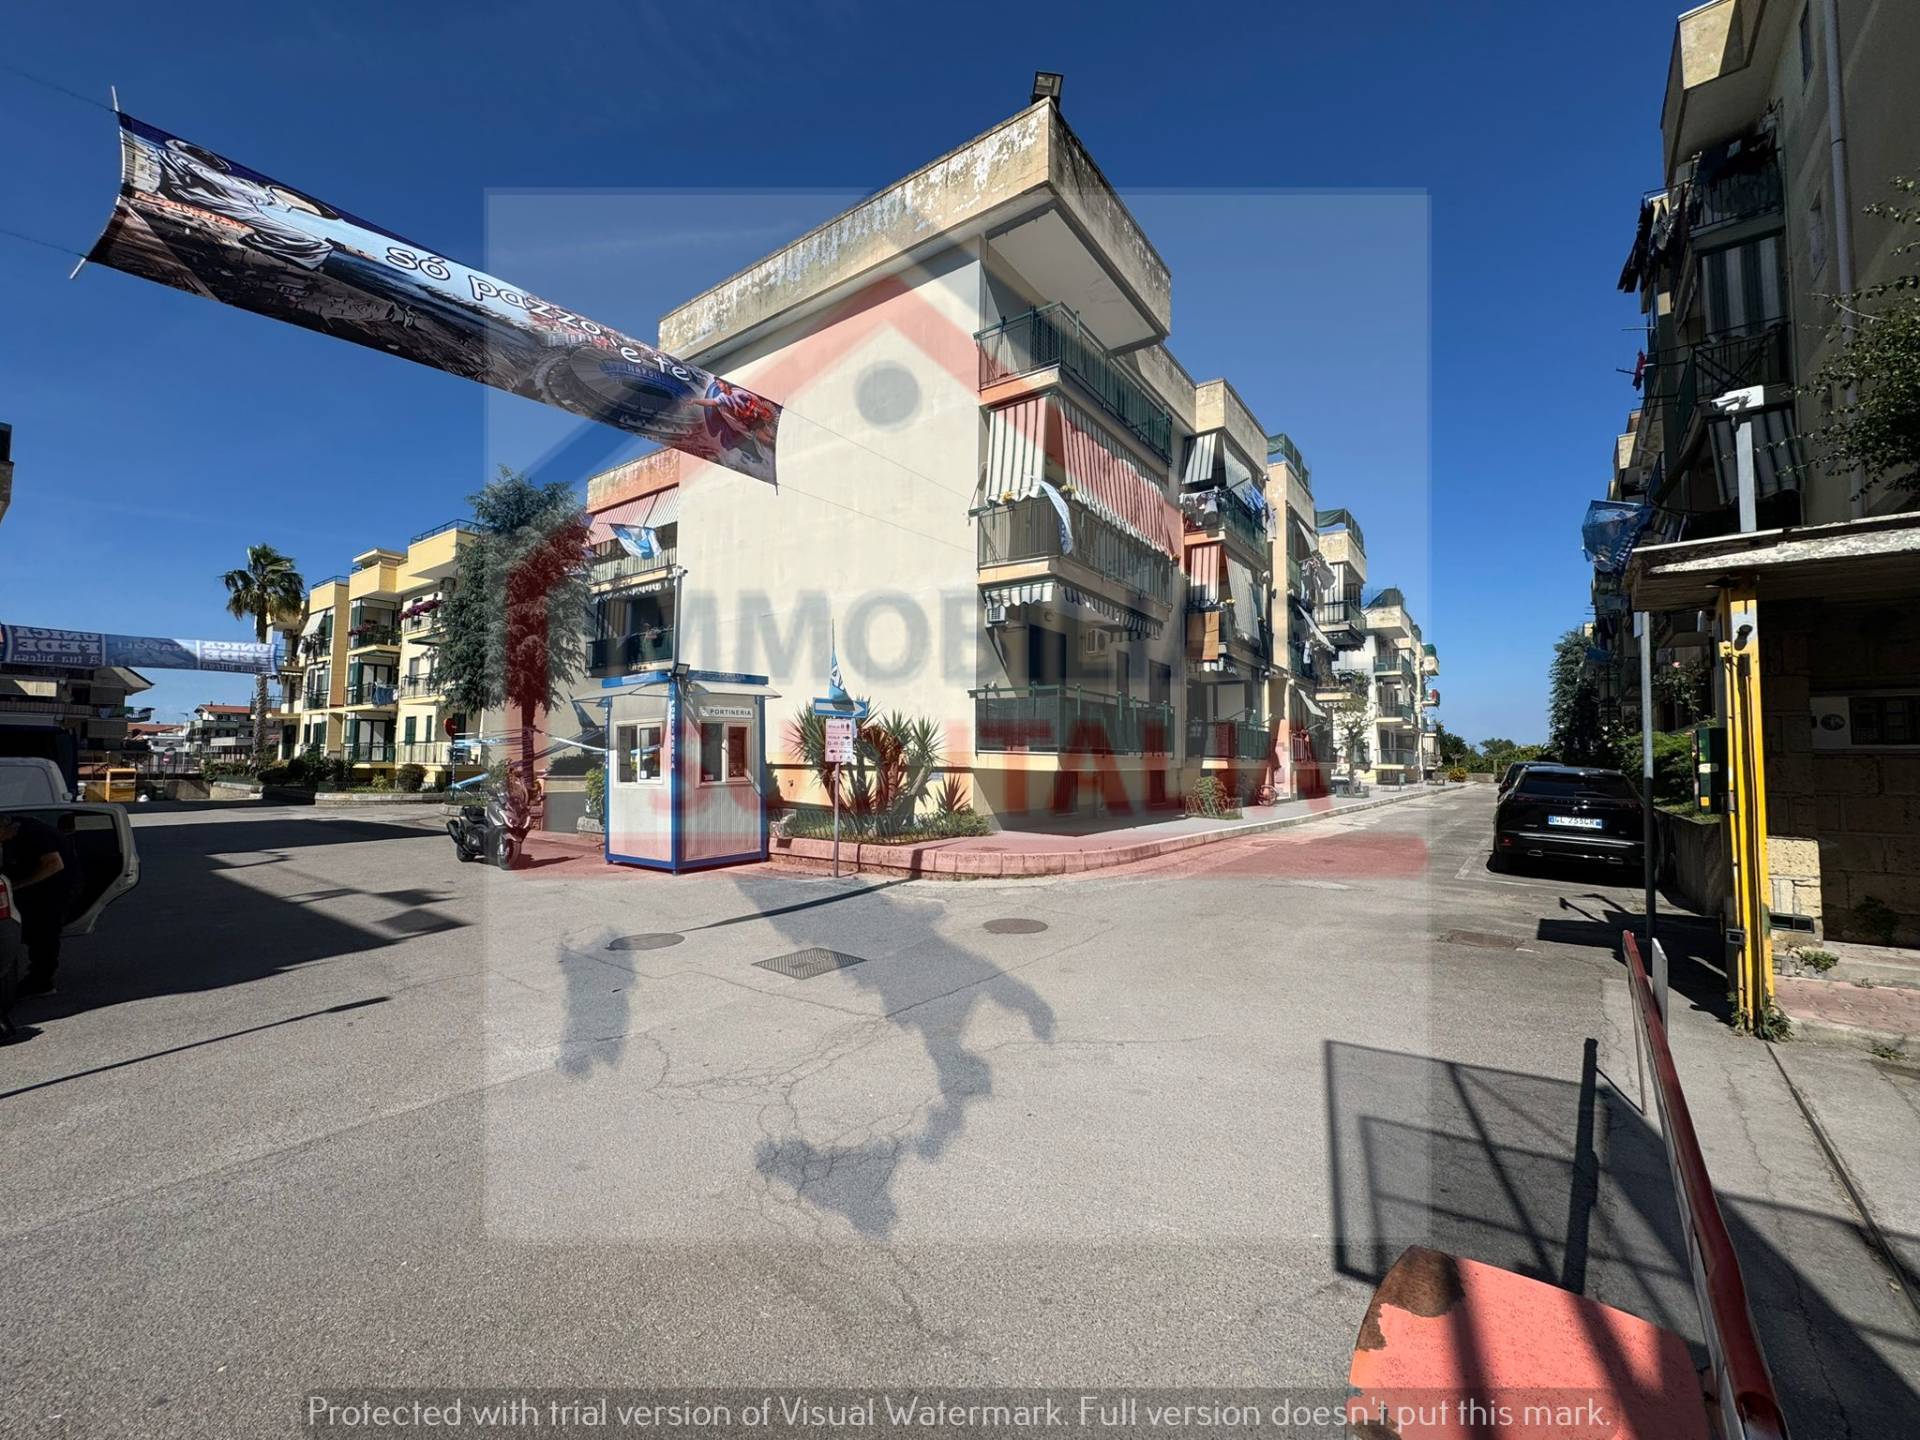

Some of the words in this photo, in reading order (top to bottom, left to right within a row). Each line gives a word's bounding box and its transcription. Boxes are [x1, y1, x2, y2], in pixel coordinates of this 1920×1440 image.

[468, 274, 602, 336] pazzo
[653, 354, 691, 382] te
[710, 708, 752, 717] PORTINERIA
